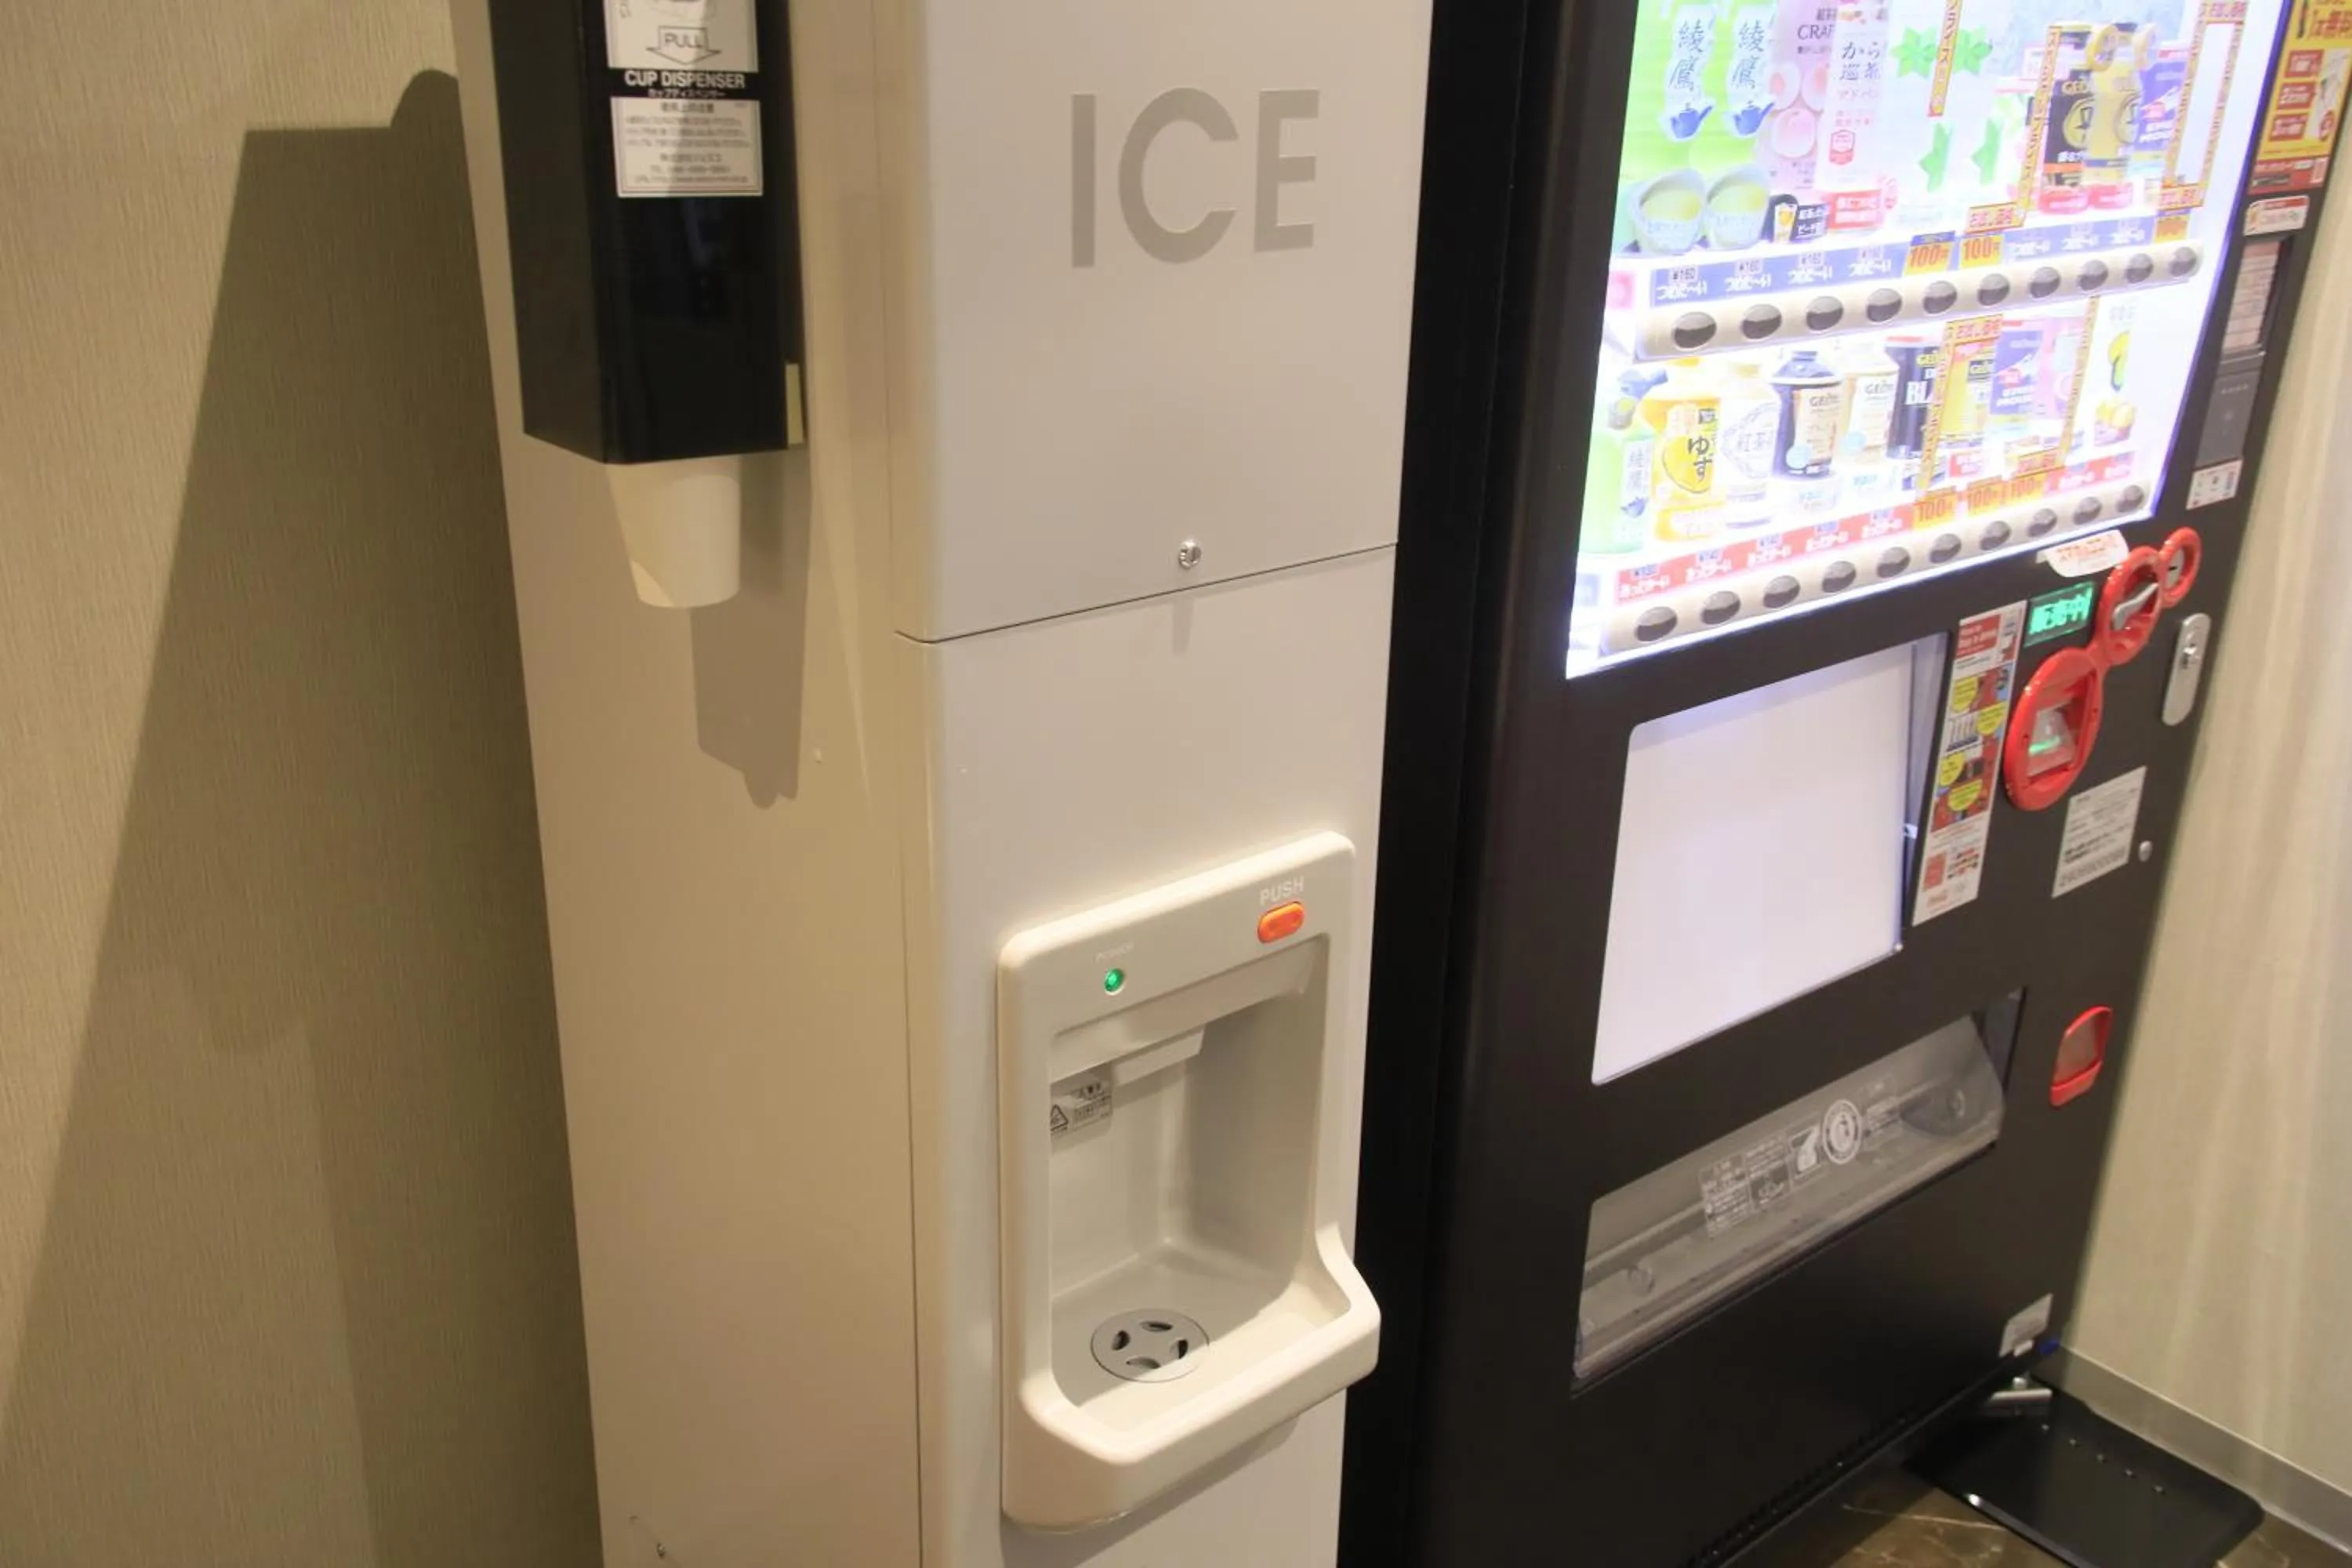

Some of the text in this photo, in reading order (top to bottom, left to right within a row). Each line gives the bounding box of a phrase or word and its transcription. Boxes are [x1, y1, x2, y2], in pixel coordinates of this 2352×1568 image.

[665, 32, 703, 49] PULL
[625, 70, 745, 88] CUP DISPENSER
[1071, 86, 1320, 268] ICE
[1259, 879, 1305, 905] PUSH
